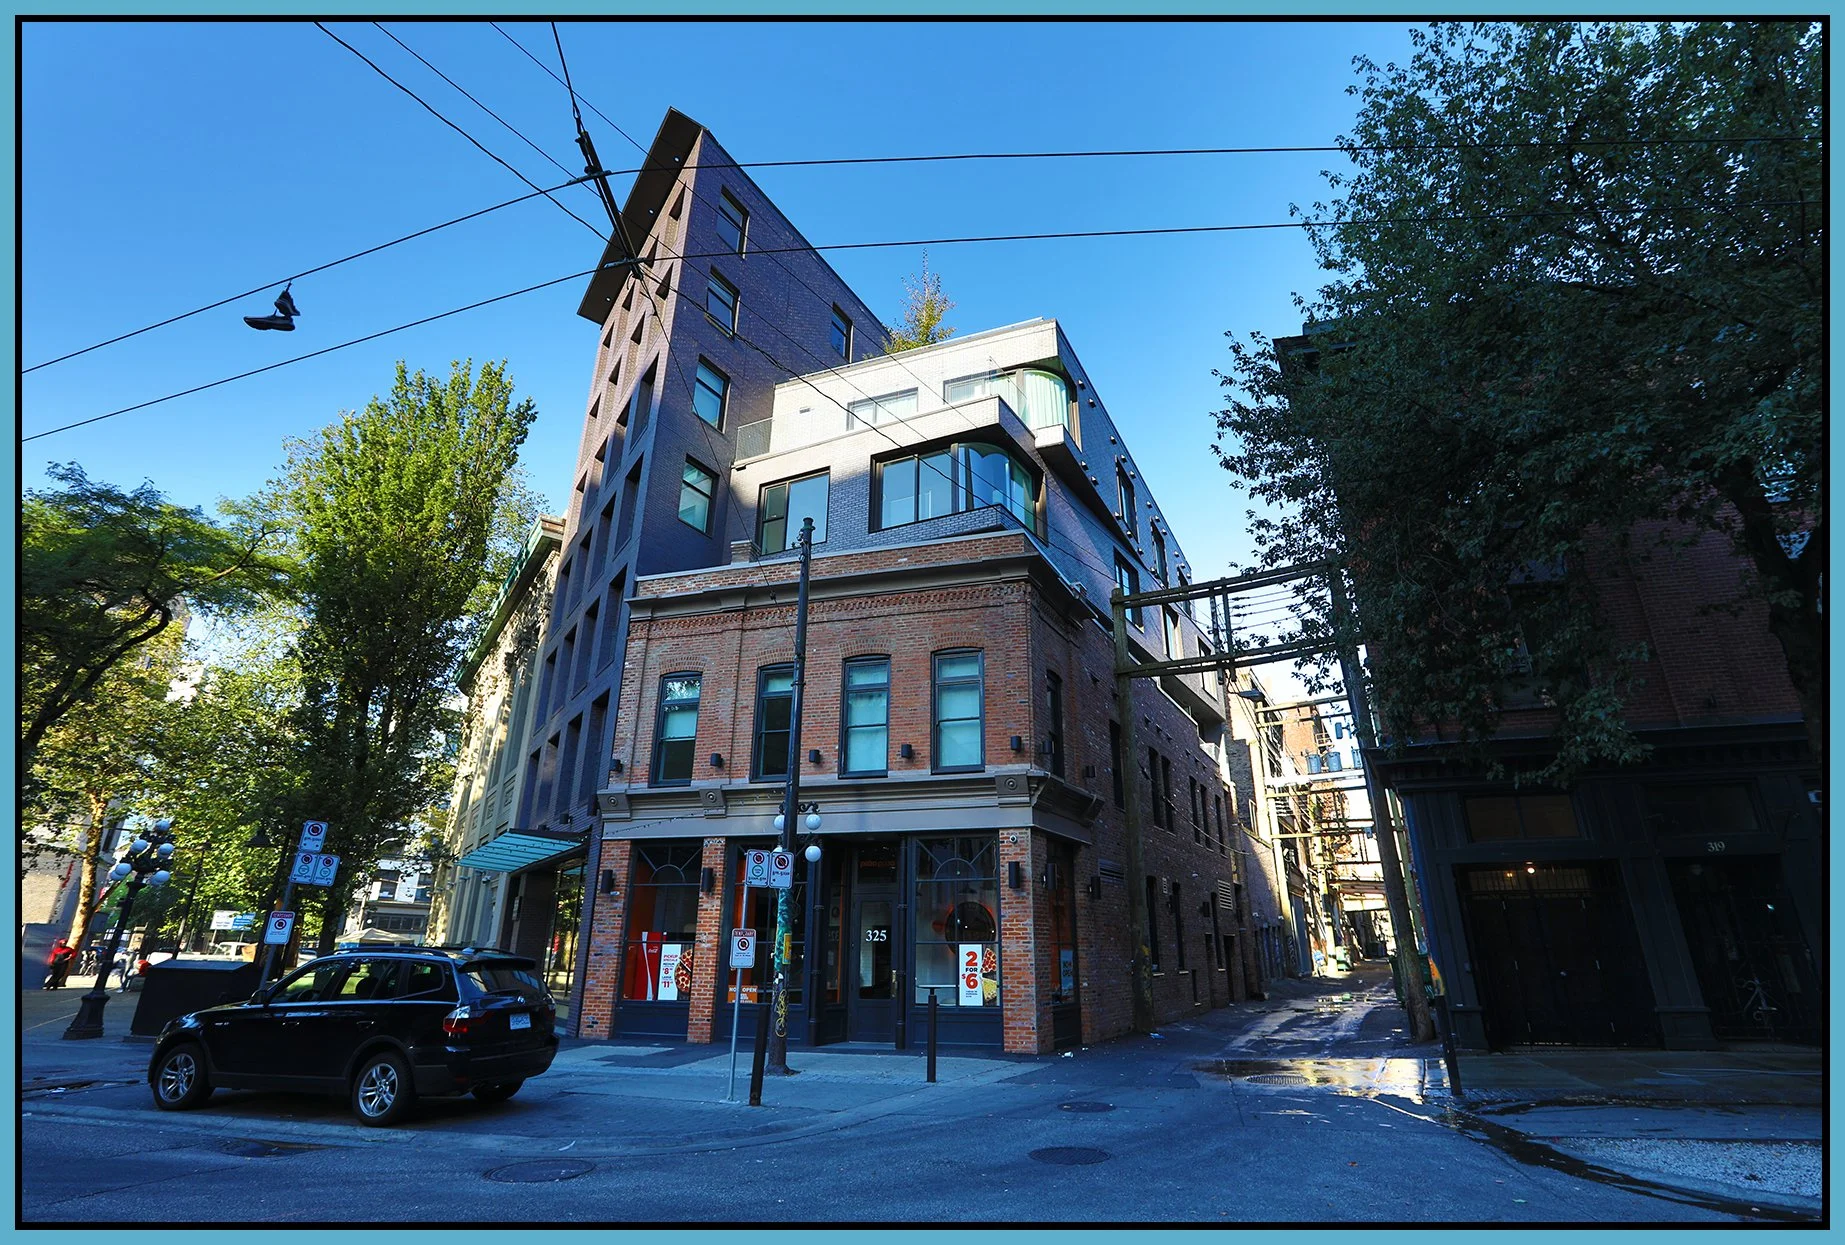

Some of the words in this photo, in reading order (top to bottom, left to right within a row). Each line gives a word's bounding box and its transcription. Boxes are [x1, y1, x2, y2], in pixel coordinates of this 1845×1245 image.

[1707, 841, 1726, 853] 319
[865, 929, 887, 942] 325
[966, 951, 978, 967] 2
